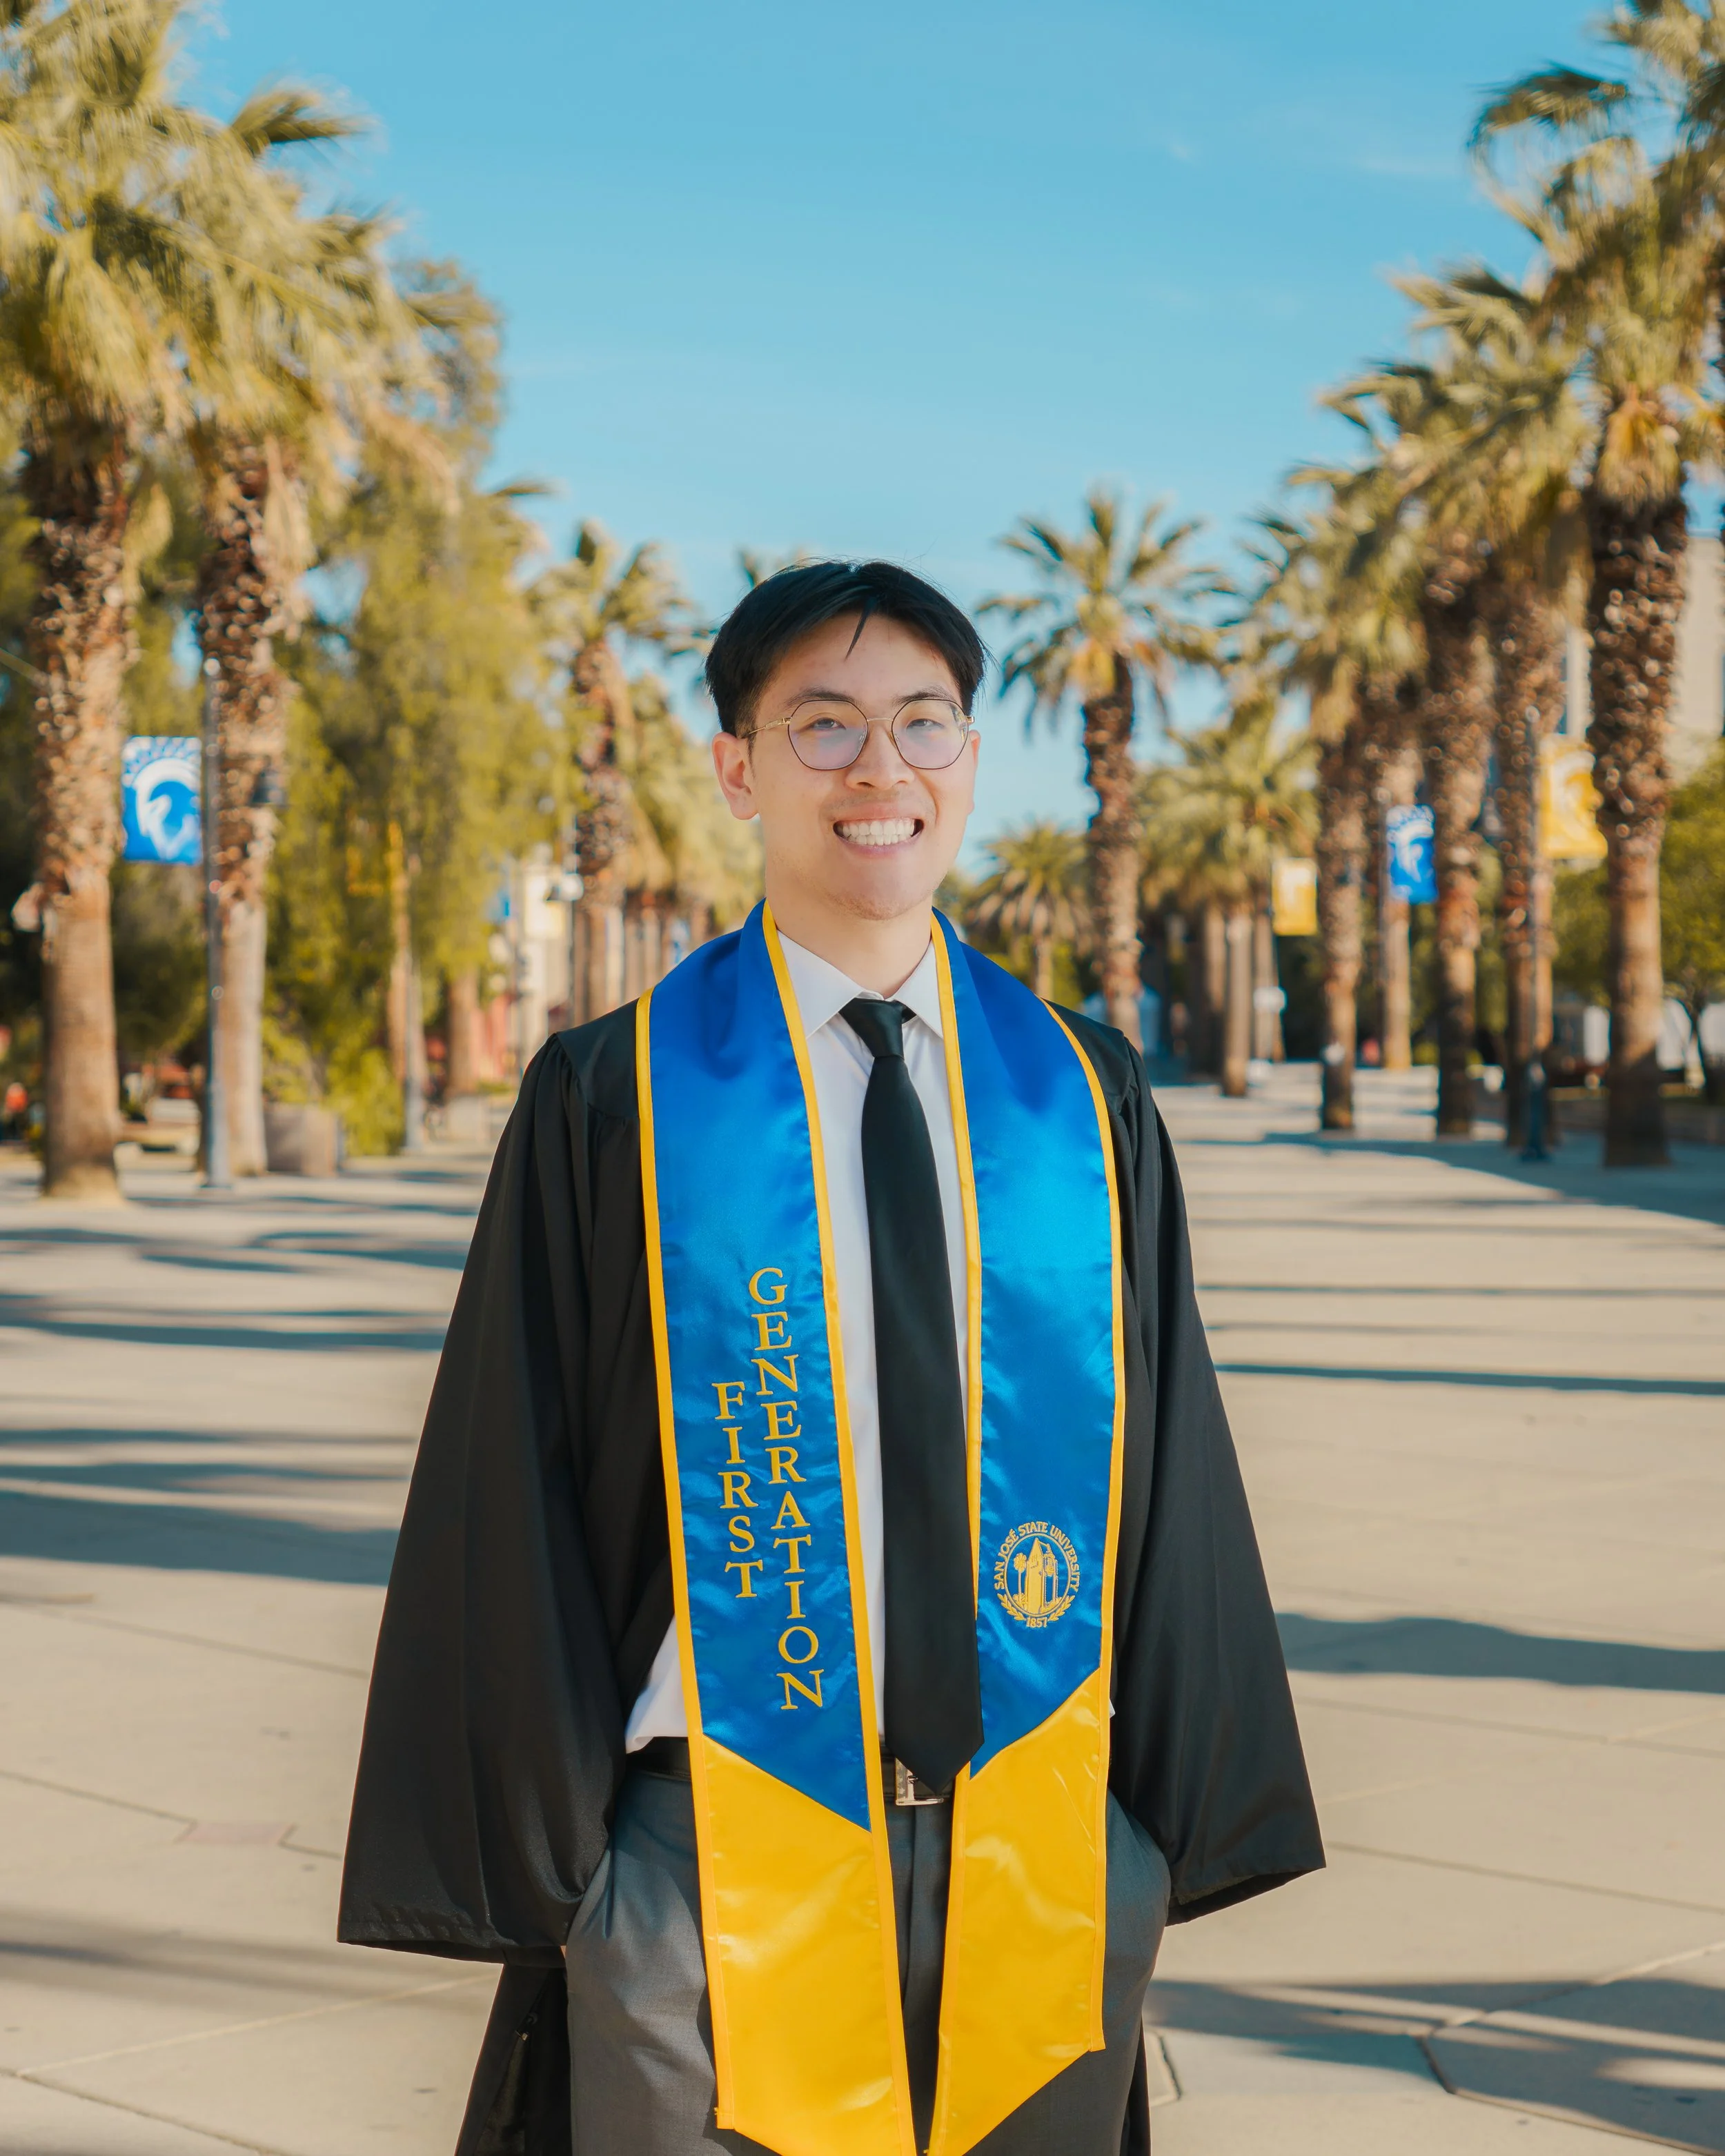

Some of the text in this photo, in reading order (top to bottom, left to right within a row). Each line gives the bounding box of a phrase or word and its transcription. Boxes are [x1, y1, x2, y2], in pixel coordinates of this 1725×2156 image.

[711, 1381, 763, 1599] FIRST
[748, 1267, 825, 1711] GENERATION
[994, 1521, 1081, 1592] SAN JOSÉ STATE UNIVERSITY
[1026, 1617, 1048, 1628] 1857
